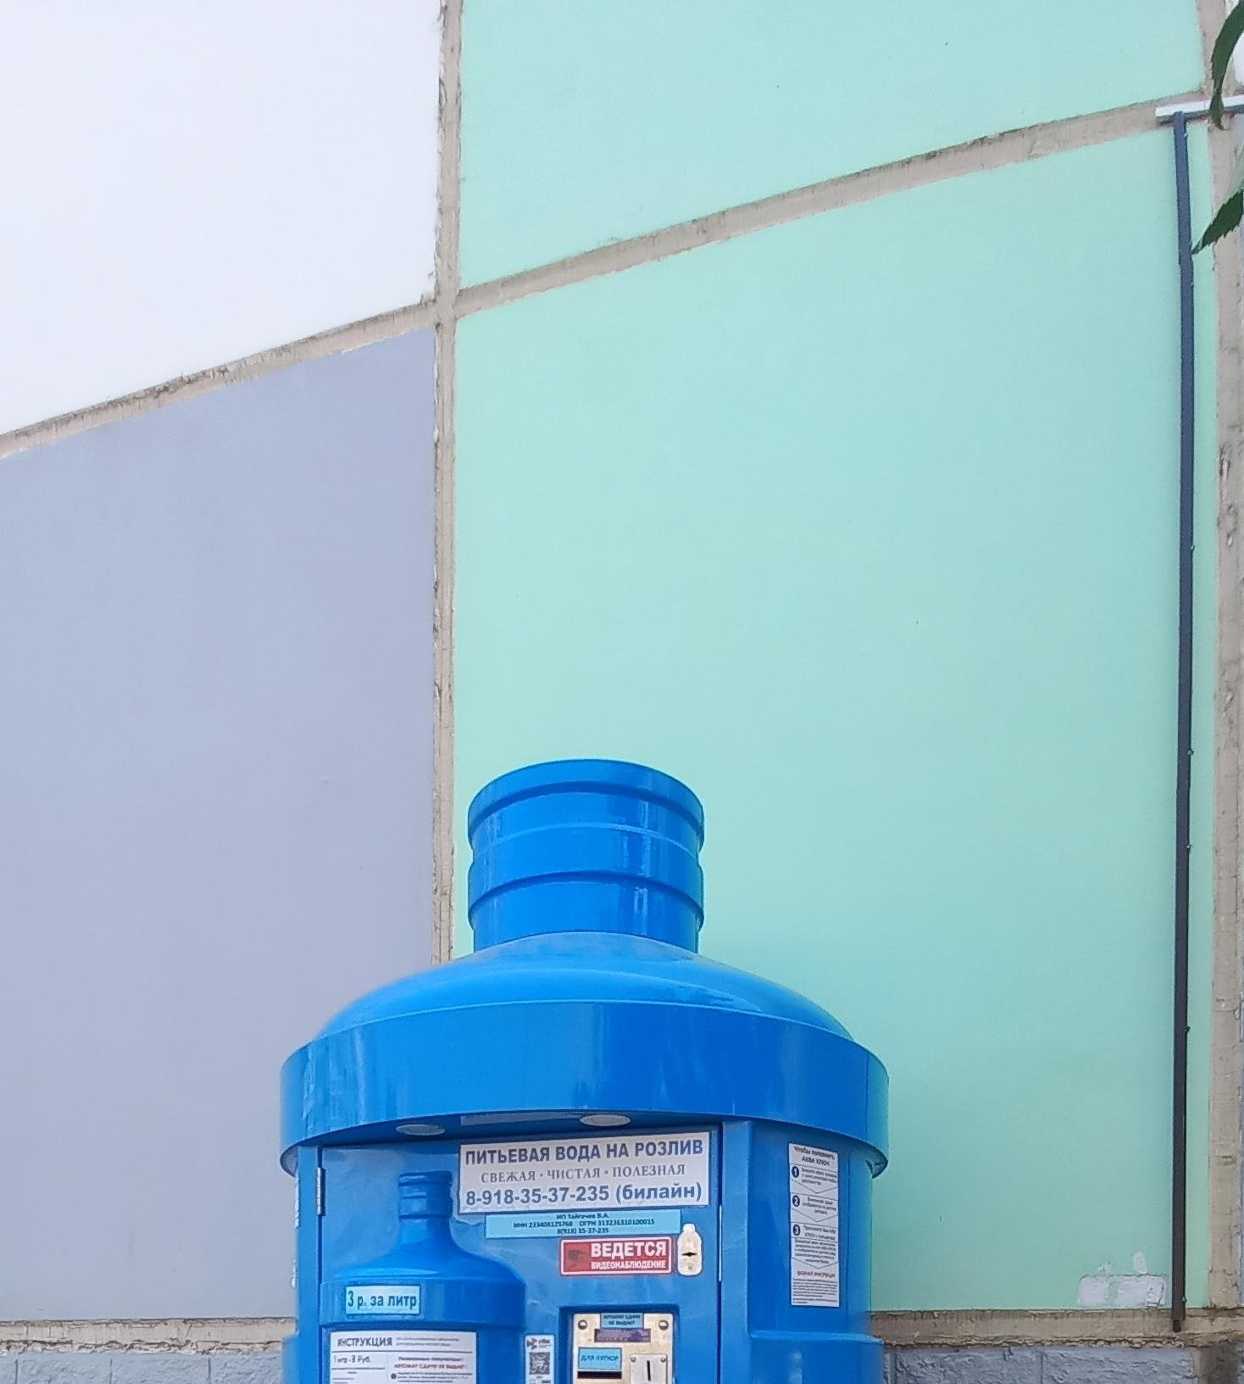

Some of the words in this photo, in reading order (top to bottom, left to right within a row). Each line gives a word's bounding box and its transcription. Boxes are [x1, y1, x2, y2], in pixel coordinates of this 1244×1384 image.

[466, 1147, 550, 1165] ПИТЬЕВАЯ
[555, 1145, 600, 1162] ВОДА
[606, 1143, 629, 1158] НА
[635, 1139, 703, 1157] РОЗЛИВ
[481, 1171, 536, 1183] СВЕЖАЯ
[546, 1168, 600, 1180] ЧИСТАЯ
[612, 1164, 685, 1177] ПОЛЕЗНАЯ
[466, 1185, 609, 1205] 8-918-35-37-235
[616, 1182, 702, 1205] (билайн)
[591, 1241, 667, 1260] ВЕДЕТСЯ
[591, 1260, 666, 1270] ВИДЕОНАБЛЮДЕНИЕ
[347, 1290, 354, 1307] 3
[370, 1296, 384, 1306] за
[387, 1296, 417, 1310] литр
[337, 1337, 393, 1348] ИНСТРУКЦИЯ
